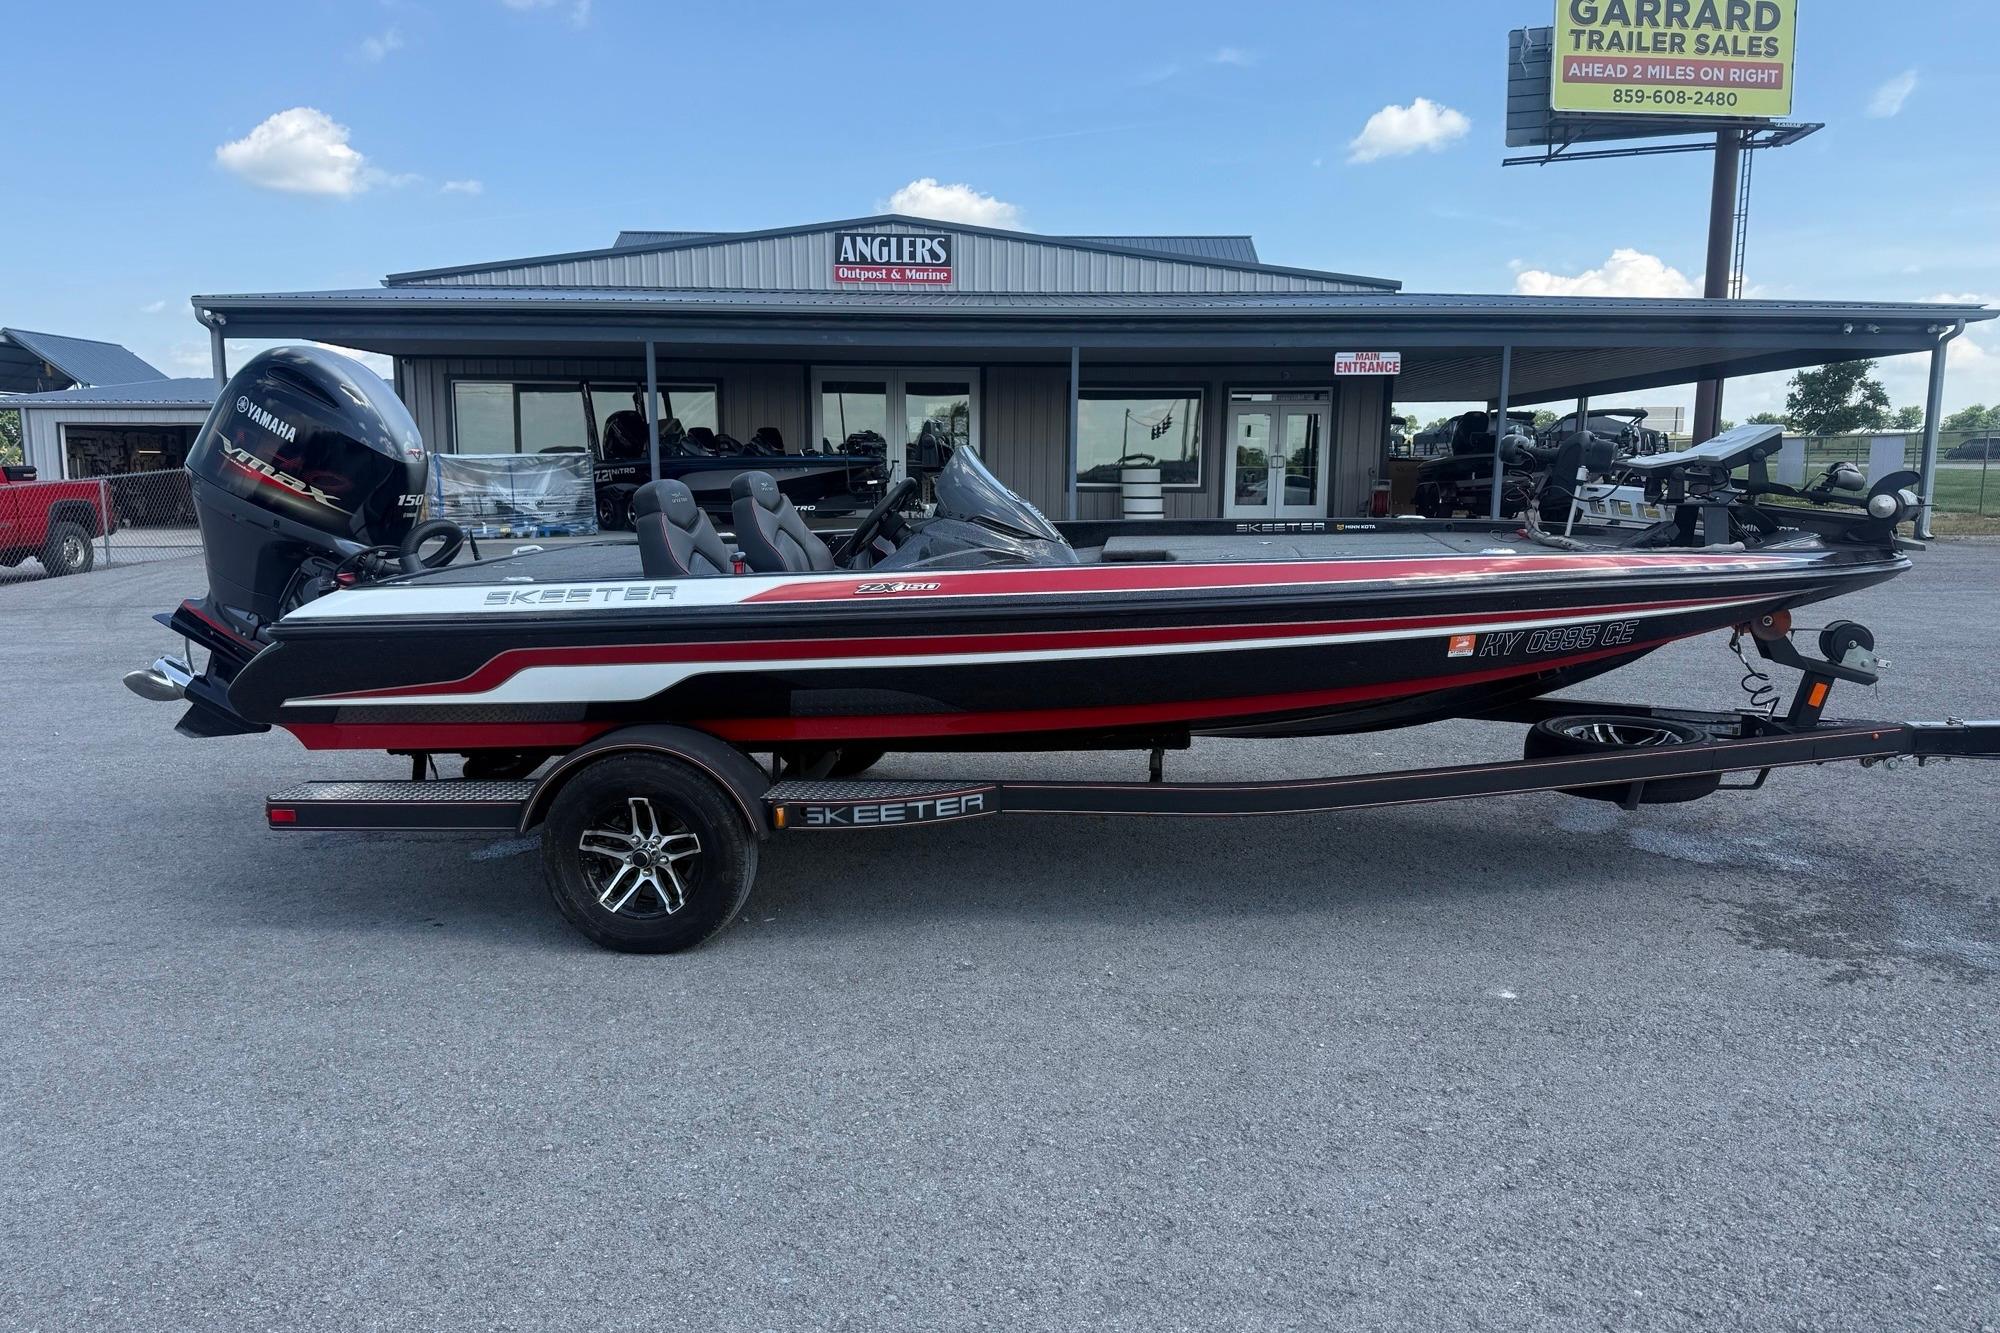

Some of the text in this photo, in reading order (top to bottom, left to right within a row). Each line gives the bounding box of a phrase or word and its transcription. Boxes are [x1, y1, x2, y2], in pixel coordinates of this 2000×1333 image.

[1568, 0, 1782, 32] GARRARD
[1568, 29, 1780, 57] TRAILER SALES
[1568, 62, 1779, 84] AHEAD 2 MILES ON RIGHT
[1612, 88, 1738, 107] 859-608-2480
[839, 236, 947, 264] ANGLERS
[838, 267, 948, 281] Outpost & Marine
[1336, 361, 1400, 373] ENTRANCE
[1355, 353, 1380, 361] MAIN
[247, 402, 297, 443] YAMAHA
[398, 494, 424, 506] 150
[1235, 522, 1326, 533] SKEETER
[484, 585, 679, 606] SKEETER
[1479, 631, 1525, 657] KY
[1600, 620, 1640, 646] CE
[806, 793, 984, 825] SKEETER
